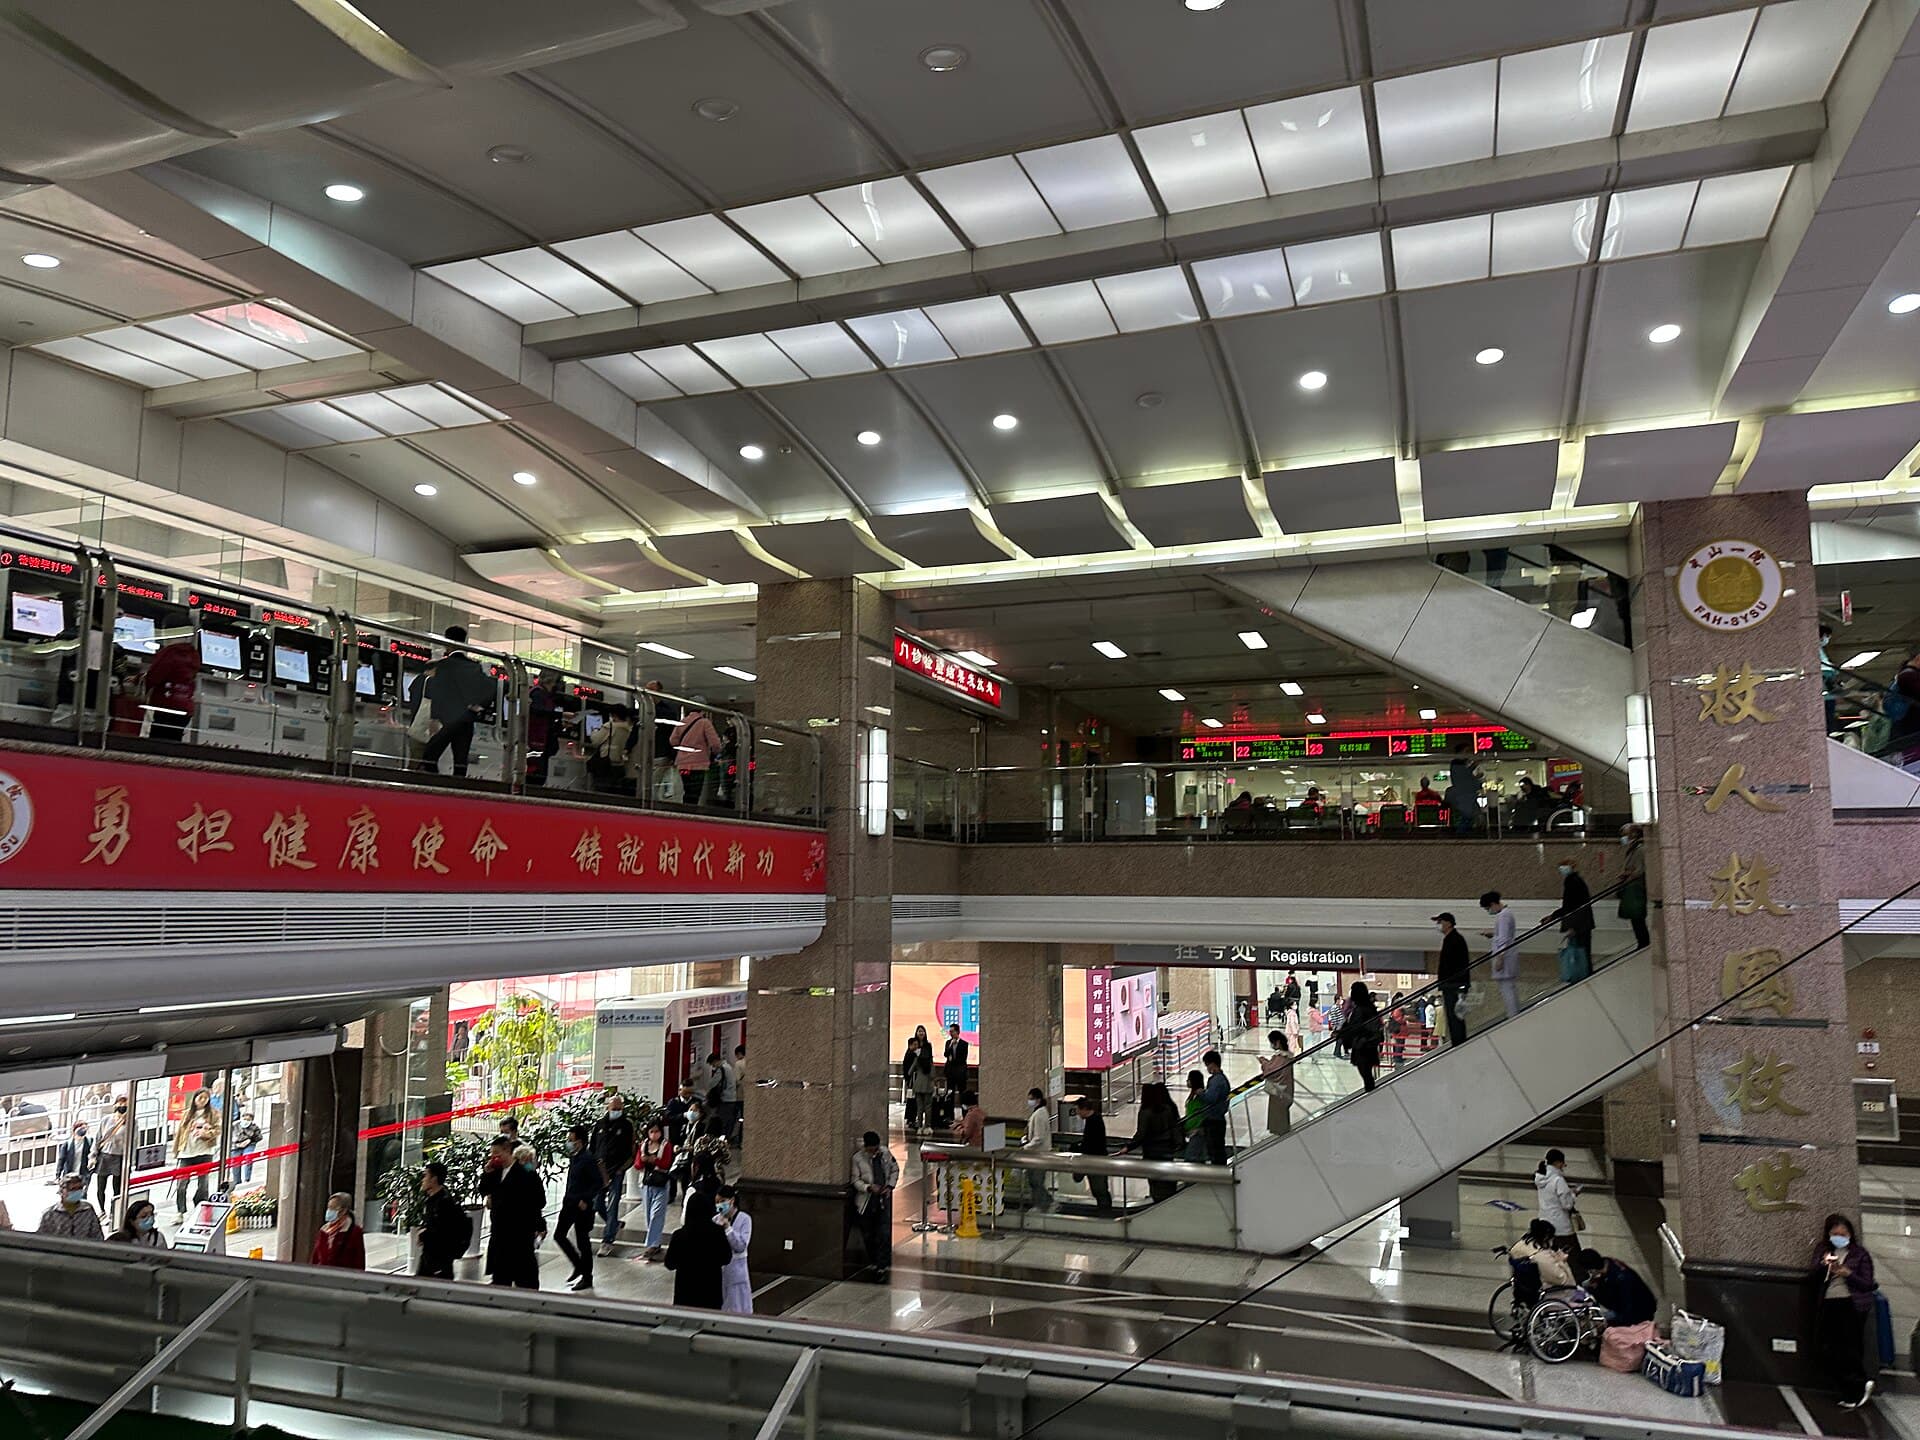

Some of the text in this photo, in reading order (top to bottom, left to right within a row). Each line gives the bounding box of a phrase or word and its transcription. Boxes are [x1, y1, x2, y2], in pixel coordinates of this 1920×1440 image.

[1689, 546, 1766, 570] 中山一院
[1694, 601, 1768, 626] FAH-SYSU
[1309, 743, 1323, 755] 23
[1392, 740, 1407, 752] 24
[1478, 737, 1493, 750] 25
[1182, 747, 1195, 759] 21
[1237, 746, 1250, 758] 22
[1269, 950, 1354, 966] Registration
[1092, 974, 1104, 1058] 医疗服务中心
